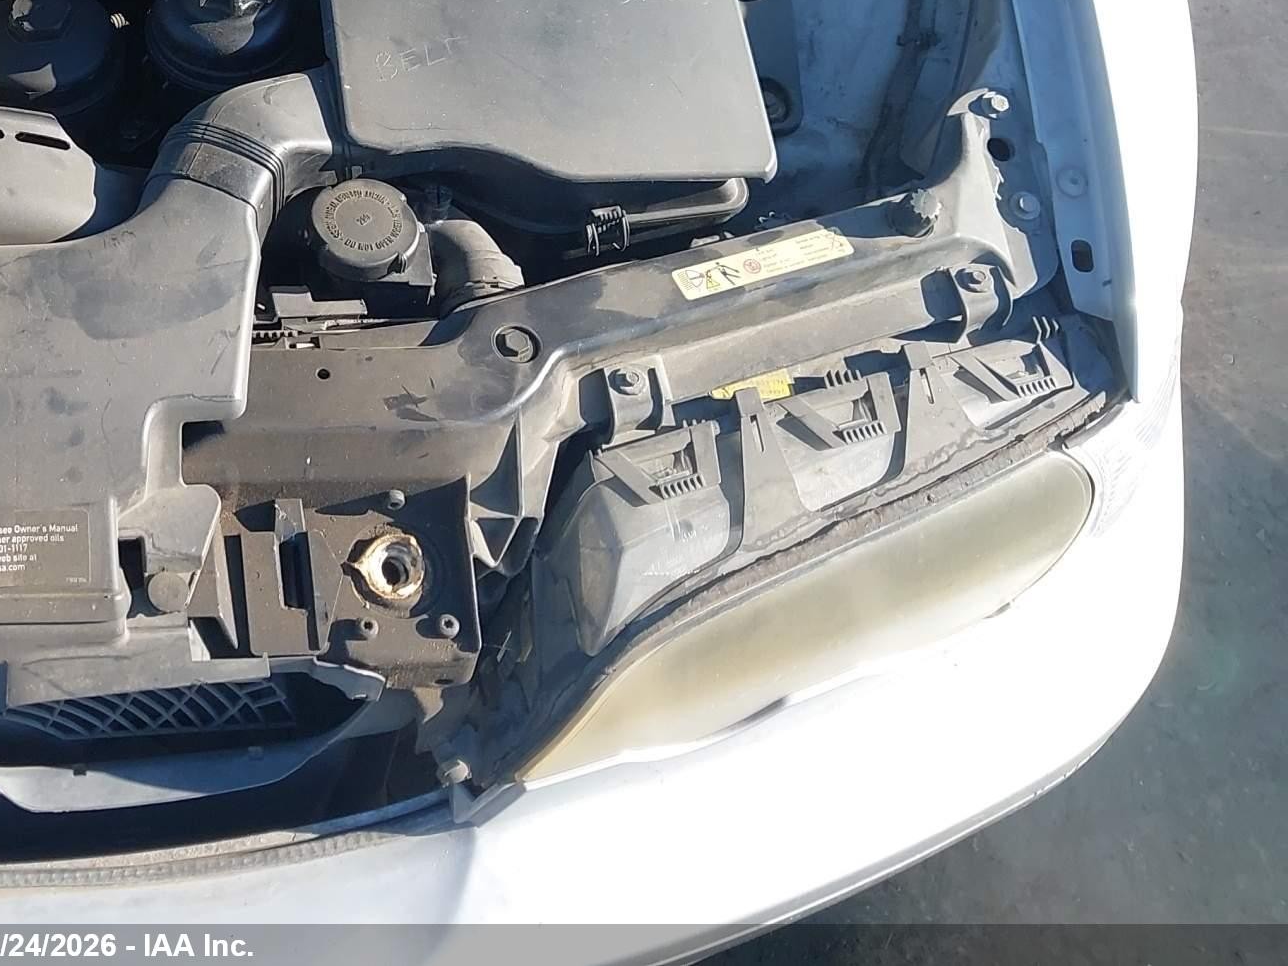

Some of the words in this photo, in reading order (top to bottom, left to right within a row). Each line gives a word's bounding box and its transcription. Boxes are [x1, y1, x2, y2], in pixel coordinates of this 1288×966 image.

[14, 524, 47, 534] Owner's
[49, 524, 78, 533] Manual
[12, 534, 48, 545] approved
[50, 534, 64, 542] oils
[13, 554, 28, 562] site
[29, 554, 37, 562] at
